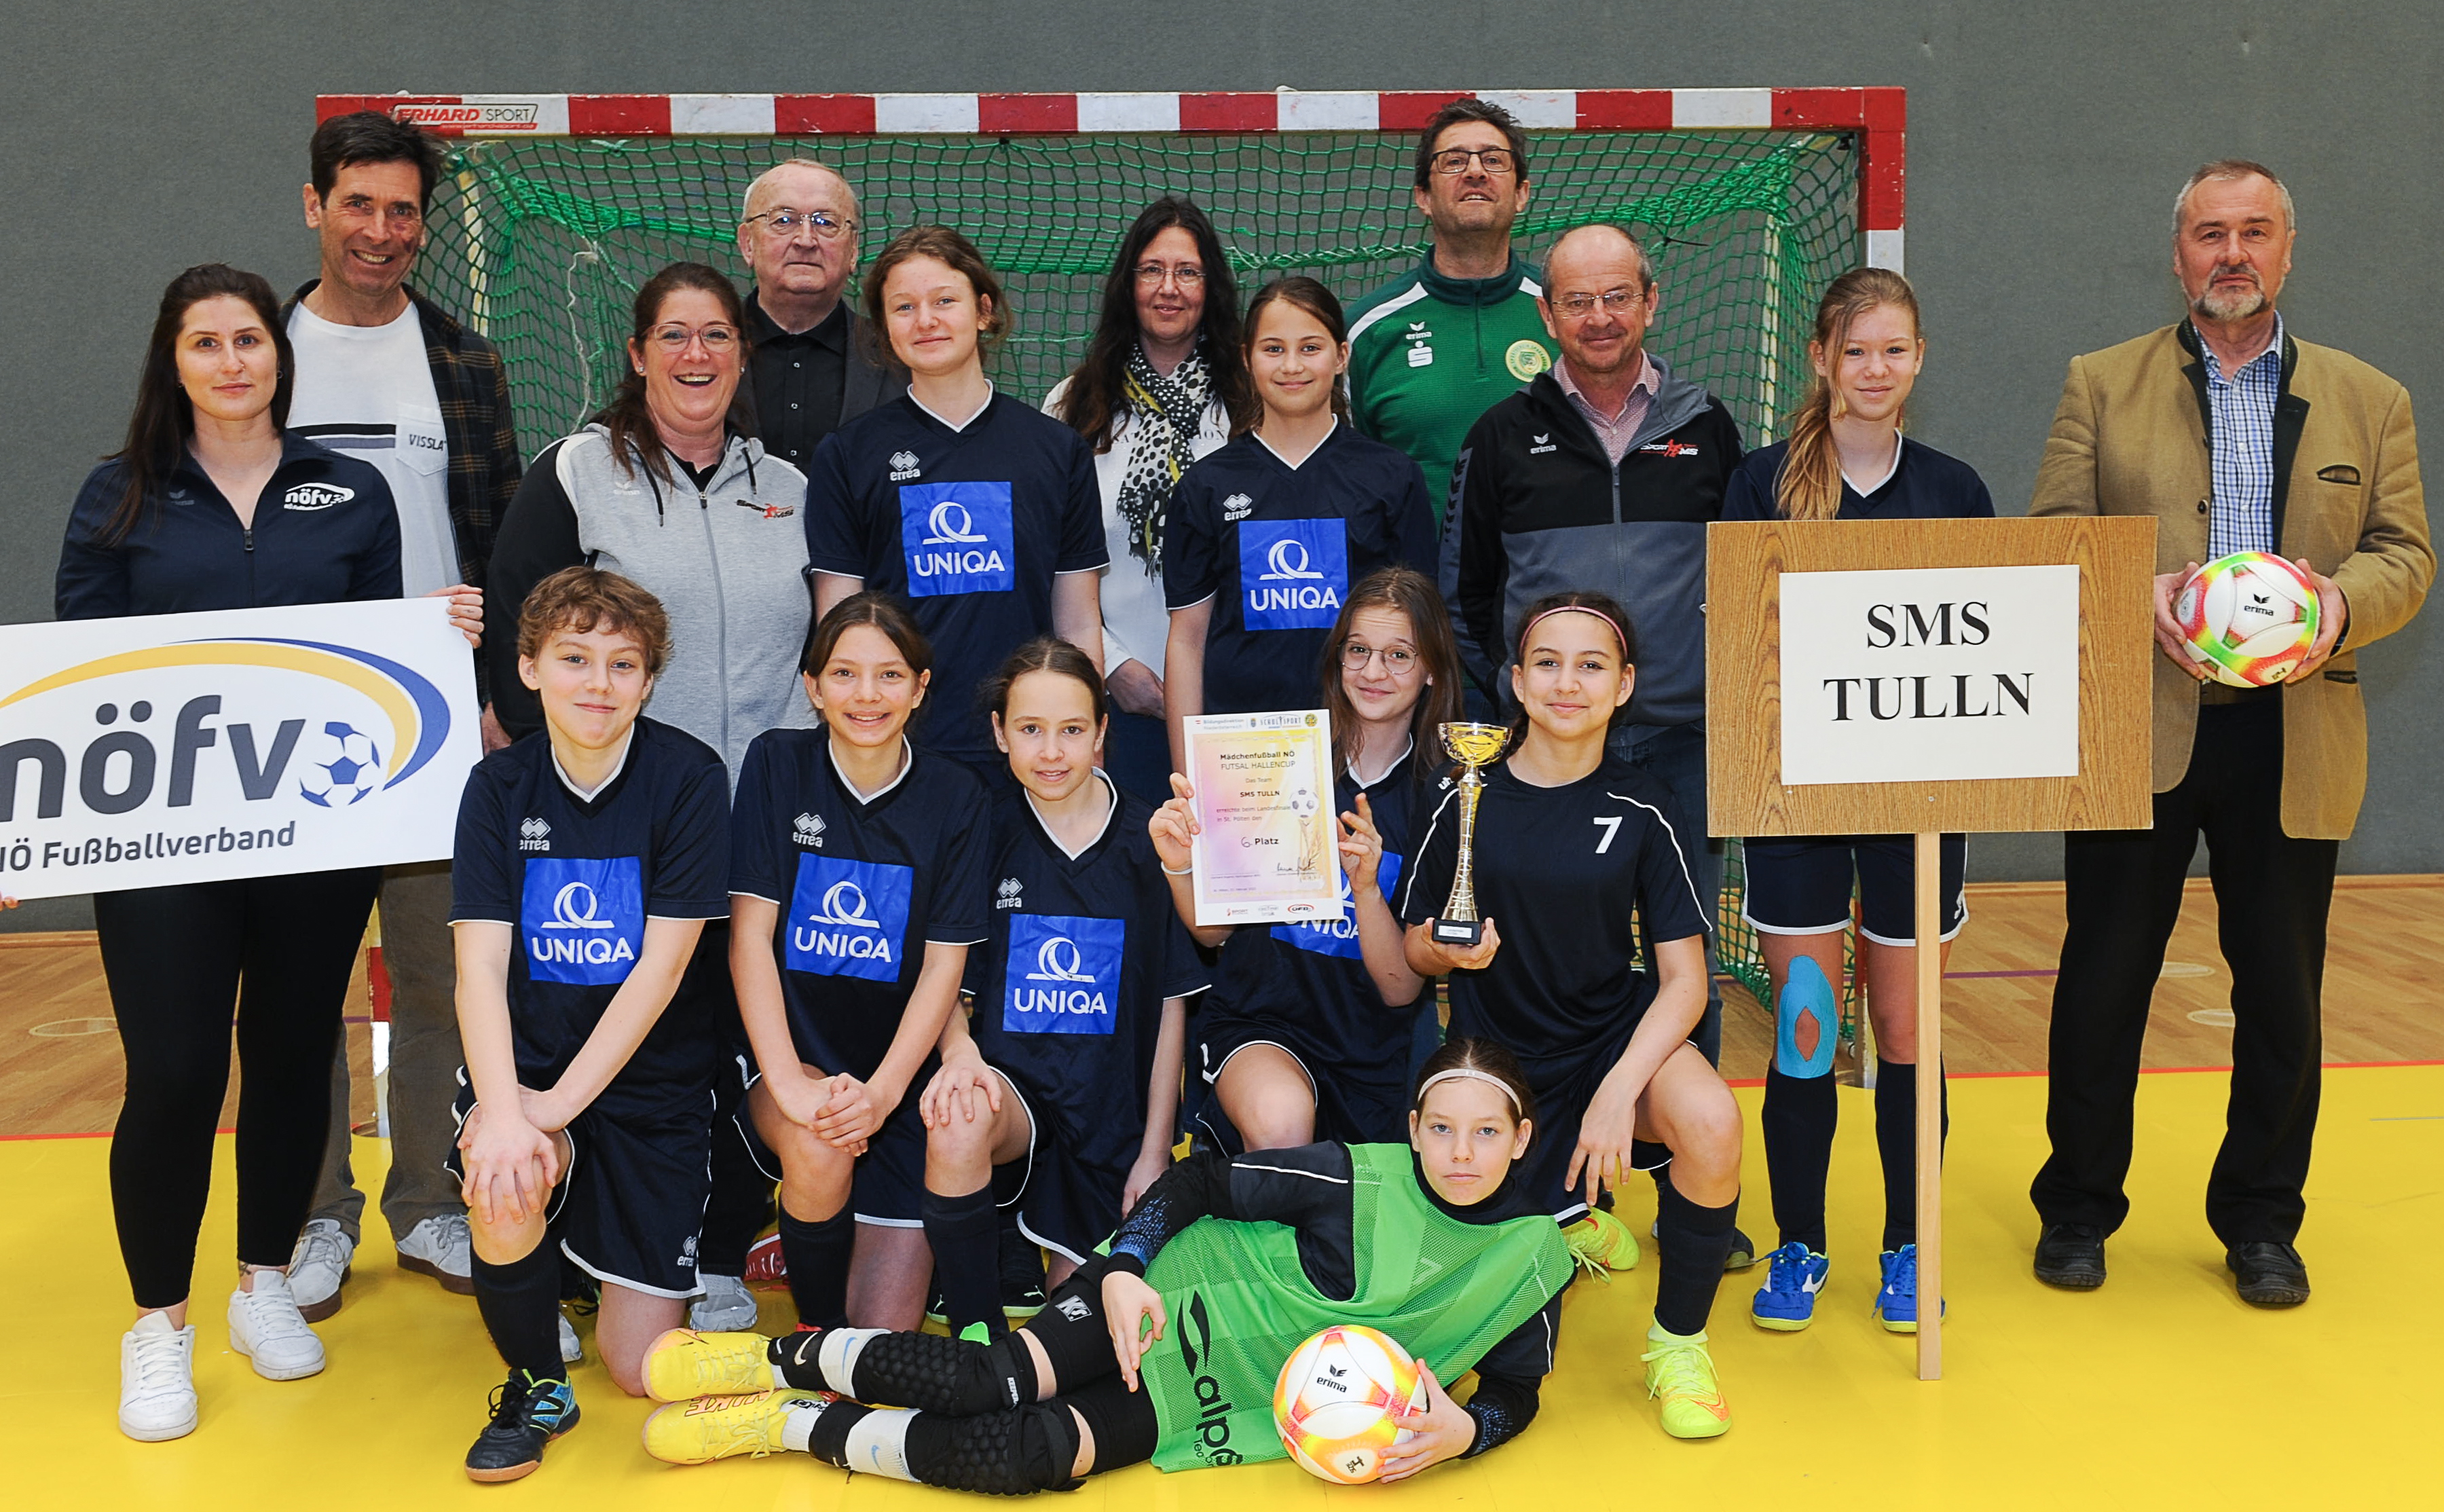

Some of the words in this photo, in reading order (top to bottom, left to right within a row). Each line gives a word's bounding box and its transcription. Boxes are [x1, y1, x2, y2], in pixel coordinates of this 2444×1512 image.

[485, 108, 530, 122] SPORT
[409, 433, 444, 451] VISSLA
[1530, 445, 1557, 454] erima
[889, 468, 921, 481] errea
[284, 488, 333, 505] nöfv
[913, 549, 1006, 577] UNIQA
[1250, 586, 1341, 612] UNIQA
[2244, 605, 2274, 616] erima
[1866, 601, 1991, 649] SMS
[1822, 673, 2035, 722] TULLN
[0, 695, 306, 824] nöfv
[1220, 752, 1281, 760] Mädchenfußball
[1283, 750, 1295, 758] NÖ
[1251, 760, 1296, 769] HALLENCUP
[793, 831, 823, 848] errea
[1255, 836, 1279, 845] Platz
[1593, 816, 1623, 854] 7
[42, 820, 296, 868] Fußballverband
[996, 896, 1022, 910] errea
[532, 937, 635, 965] UNIQA
[794, 926, 892, 963] UNIQA
[1014, 988, 1108, 1014] UNIQA
[1316, 1376, 1348, 1393] erima
